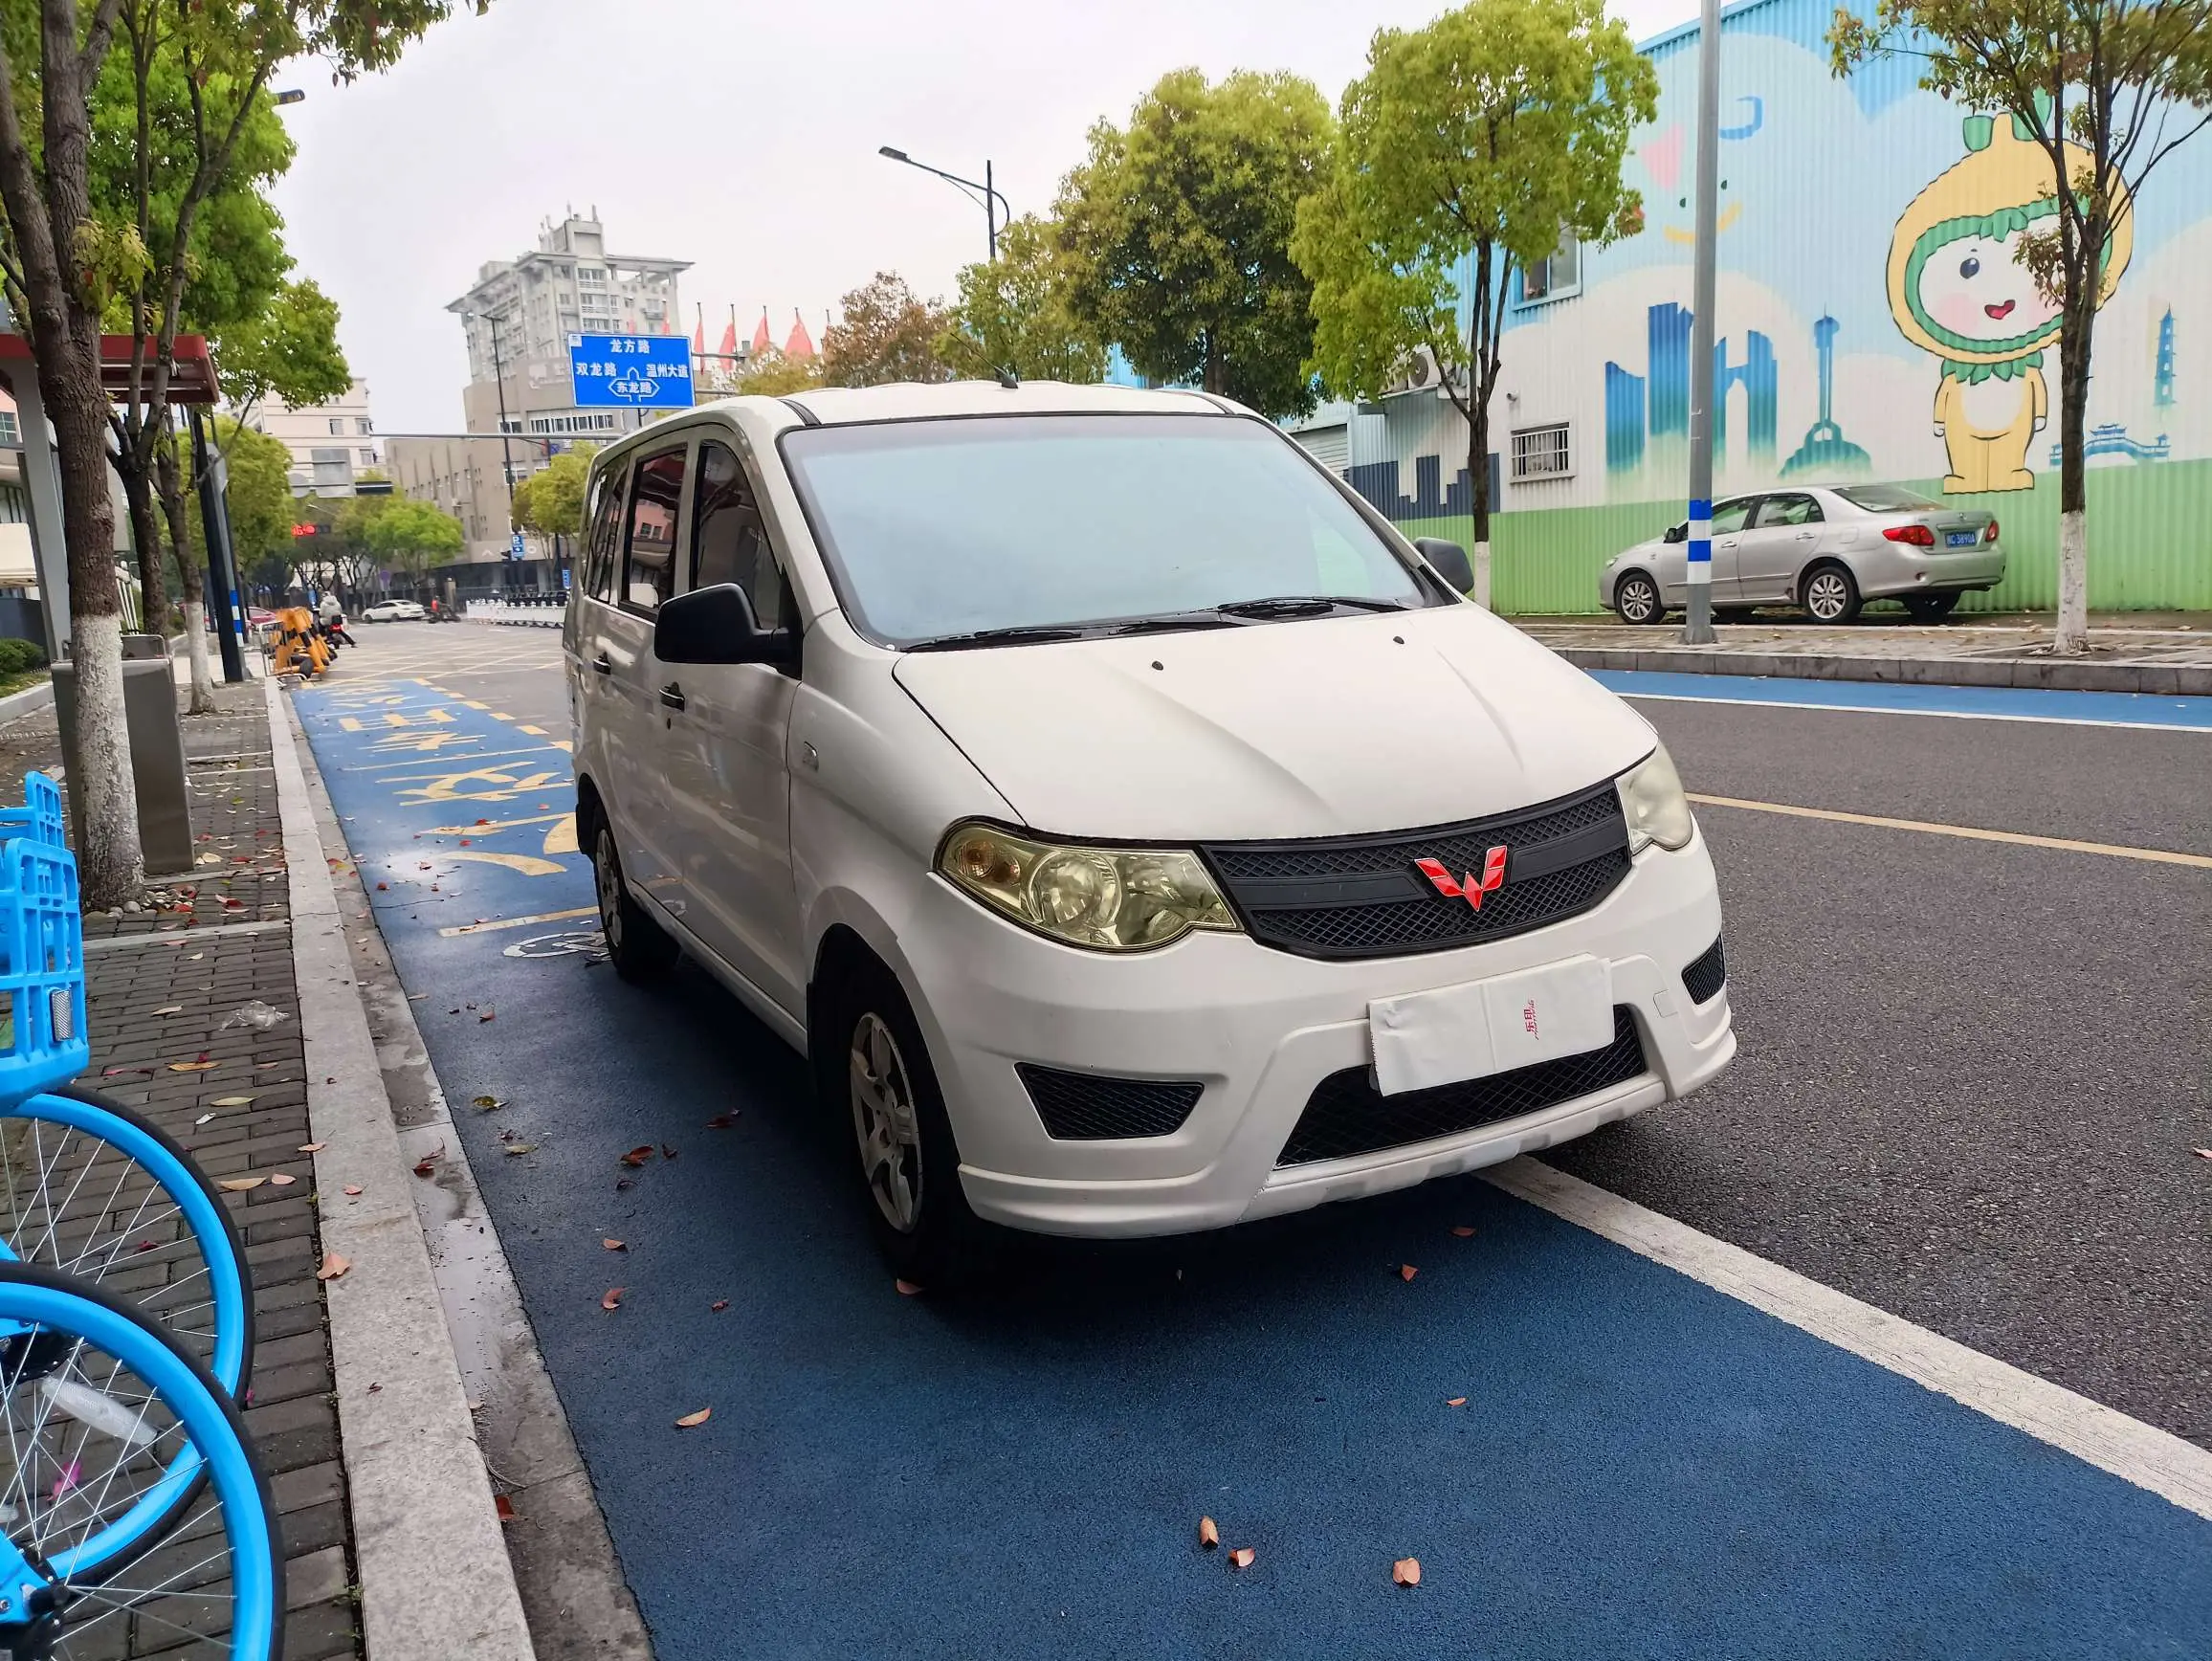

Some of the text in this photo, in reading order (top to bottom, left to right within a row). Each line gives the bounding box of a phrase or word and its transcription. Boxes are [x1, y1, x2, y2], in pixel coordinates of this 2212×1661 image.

[610, 339, 650, 354] 龙方路
[576, 363, 617, 377] 双龙路
[646, 364, 690, 378] 温州大道
[616, 382, 653, 394] 东龙路
